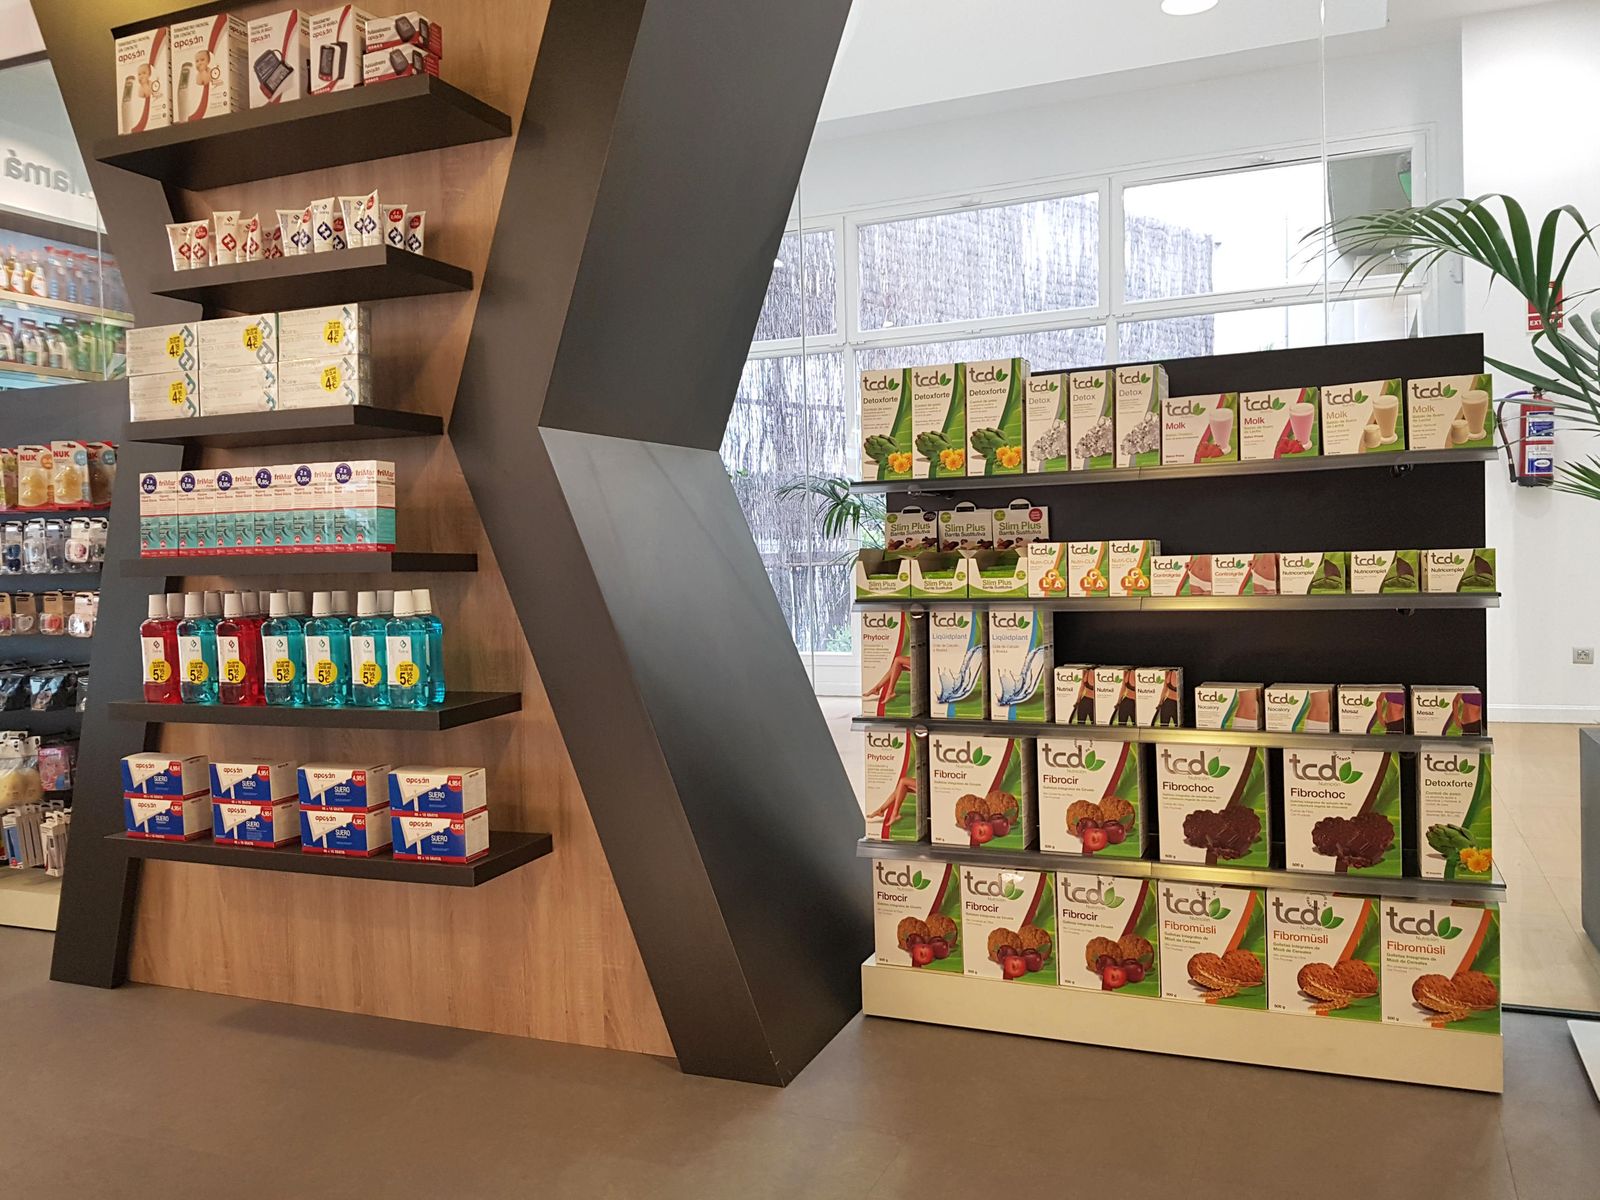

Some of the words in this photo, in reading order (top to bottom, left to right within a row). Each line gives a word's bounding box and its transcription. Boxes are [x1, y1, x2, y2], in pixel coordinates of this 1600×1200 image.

[914, 370, 940, 387] tcd
[969, 366, 996, 383] tcd
[1119, 371, 1140, 384] tcd
[863, 375, 888, 391] tcd
[1028, 380, 1049, 393] tcd
[1072, 376, 1094, 389] tcd
[914, 392, 950, 400] Detoxforte
[969, 388, 1007, 397] Detoxforte
[1119, 389, 1142, 397] Detox
[1411, 382, 1443, 399] tcd
[863, 396, 898, 405] Detoxforte
[1244, 394, 1273, 411] tcd
[1325, 388, 1356, 406] tcd
[1165, 400, 1194, 417] tcd
[1412, 404, 1435, 413] Molk
[1244, 417, 1264, 425] Molk
[1326, 411, 1348, 420] Molk
[1166, 422, 1186, 430] Molk
[53, 450, 70, 458] NUK
[890, 523, 909, 532] Slim
[911, 522, 930, 530] Plus
[945, 524, 964, 532] Slim
[966, 523, 986, 531] Plus
[999, 522, 1018, 531] Slim
[1021, 522, 1042, 530] Plus
[1030, 545, 1048, 555] tcd
[1071, 544, 1089, 554] tcd
[1111, 543, 1131, 554] tcd
[1153, 559, 1174, 570] tcd
[1214, 557, 1236, 569] tcd
[1282, 556, 1304, 567] tcd
[1354, 554, 1377, 566] tcd
[1430, 553, 1454, 564] tcd
[863, 613, 888, 628] tcd
[932, 613, 957, 627] tcd
[992, 613, 1018, 628] tcd
[863, 633, 890, 641] Phytocir
[1056, 672, 1074, 682] tcd
[1096, 672, 1114, 683] tcd
[1137, 673, 1156, 683] tcd
[1197, 690, 1218, 702] tcd
[1267, 692, 1289, 704] tcd
[1341, 694, 1363, 706] tcd
[1416, 695, 1439, 707] tcd
[867, 732, 892, 748] tcd
[867, 753, 895, 761] Phytocir
[934, 739, 974, 764] tcd
[1042, 743, 1086, 769] tcd
[1161, 749, 1209, 775] tcd
[1289, 754, 1340, 781] tcd
[1424, 754, 1460, 772] tcd
[934, 770, 967, 780] Fibrocir
[1043, 774, 1079, 784] Fibrocir
[1162, 781, 1214, 793] Fibrochoc
[1425, 779, 1473, 787] Detoxforte
[428, 791, 445, 799] SUERO
[1291, 788, 1345, 799] Fibrochoc
[335, 829, 350, 837] SUERO
[876, 862, 914, 888] tcd
[964, 871, 1006, 897] tcd
[877, 892, 908, 902] Fibrocir
[1061, 877, 1104, 905] tcd
[965, 901, 999, 913] Fibrocir
[1163, 888, 1209, 916] tcd
[1062, 909, 1098, 921] Fibrocir
[1272, 897, 1321, 927] tcd
[1164, 920, 1217, 934] Fibromüsli
[1386, 907, 1438, 937] tcd
[1273, 930, 1328, 944] Fibromüsli
[1387, 941, 1446, 955] Fibromüsli
